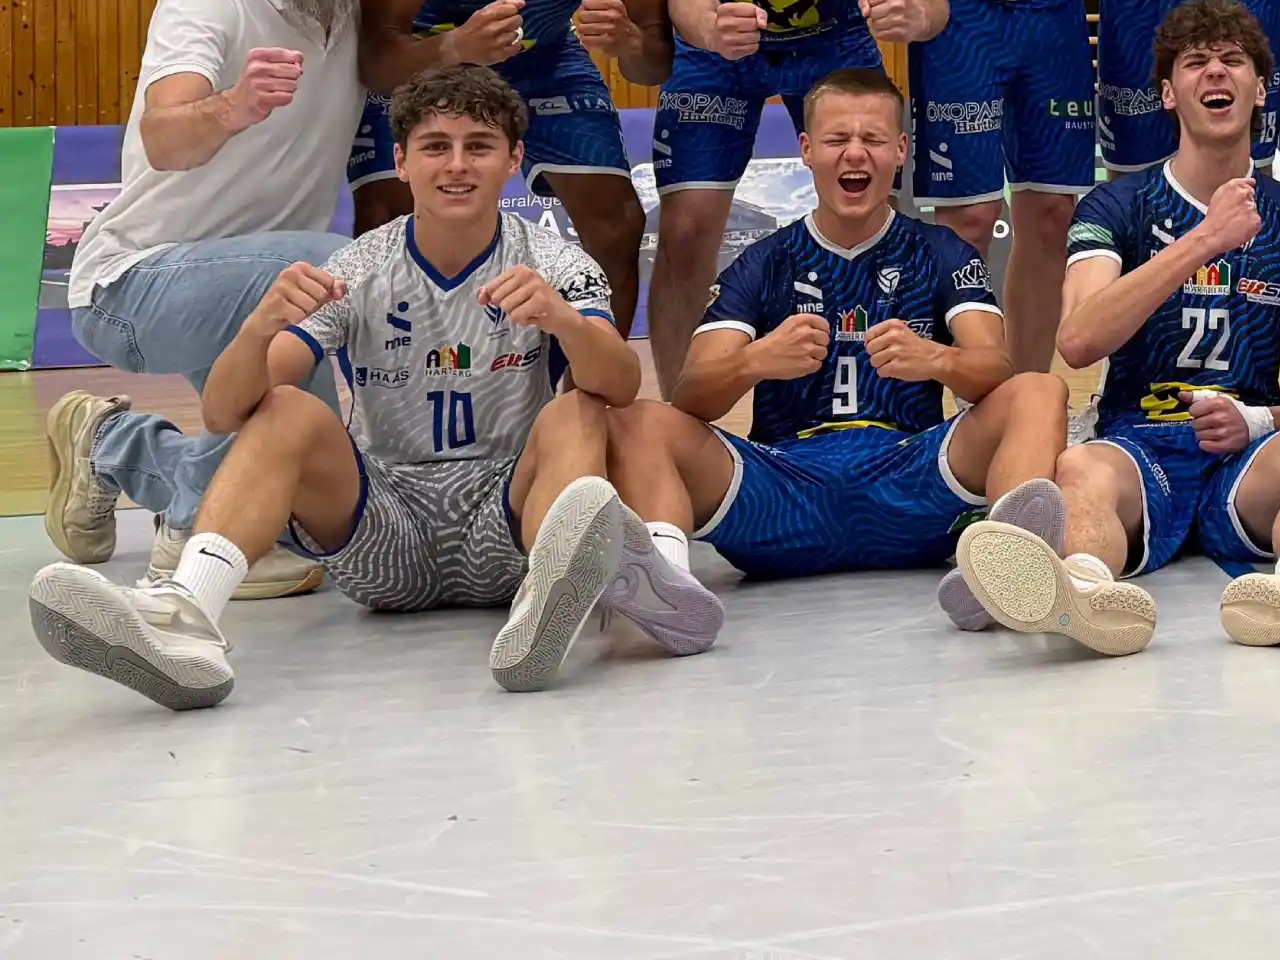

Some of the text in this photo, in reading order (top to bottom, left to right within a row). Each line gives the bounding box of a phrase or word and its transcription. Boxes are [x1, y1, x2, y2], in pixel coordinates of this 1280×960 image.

[658, 90, 749, 115] ÖKOPARK
[796, 301, 824, 314] nine
[1176, 307, 1231, 371] 22
[370, 369, 410, 383] HAAS
[832, 356, 858, 415] 9
[426, 390, 477, 453] 10
